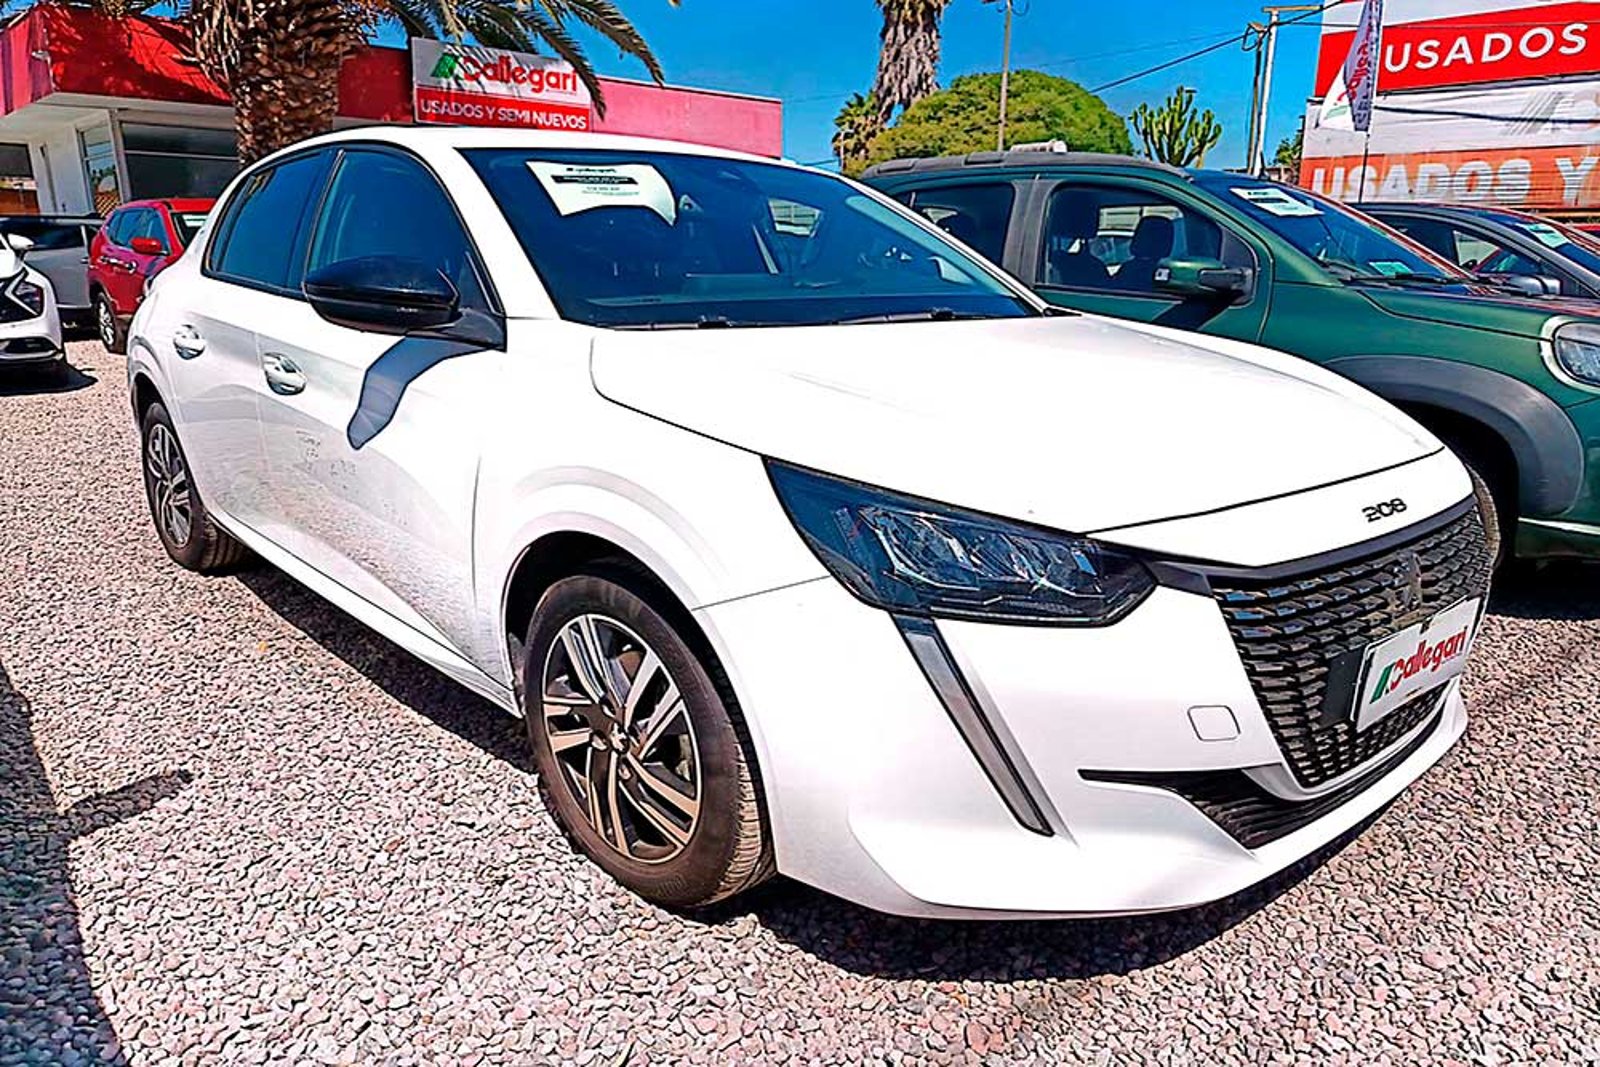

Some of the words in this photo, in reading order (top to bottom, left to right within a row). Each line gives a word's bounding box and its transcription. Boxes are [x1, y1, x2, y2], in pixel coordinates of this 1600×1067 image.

[1384, 22, 1588, 73] USADOS
[462, 55, 577, 93] Callegari
[421, 100, 483, 119] USADOS
[485, 107, 496, 120] Y
[533, 112, 587, 129] NUEVOS
[1311, 158, 1532, 202] USADOS
[1556, 156, 1600, 206] Y
[1362, 498, 1407, 522] 208
[1390, 625, 1468, 691] Callegari
